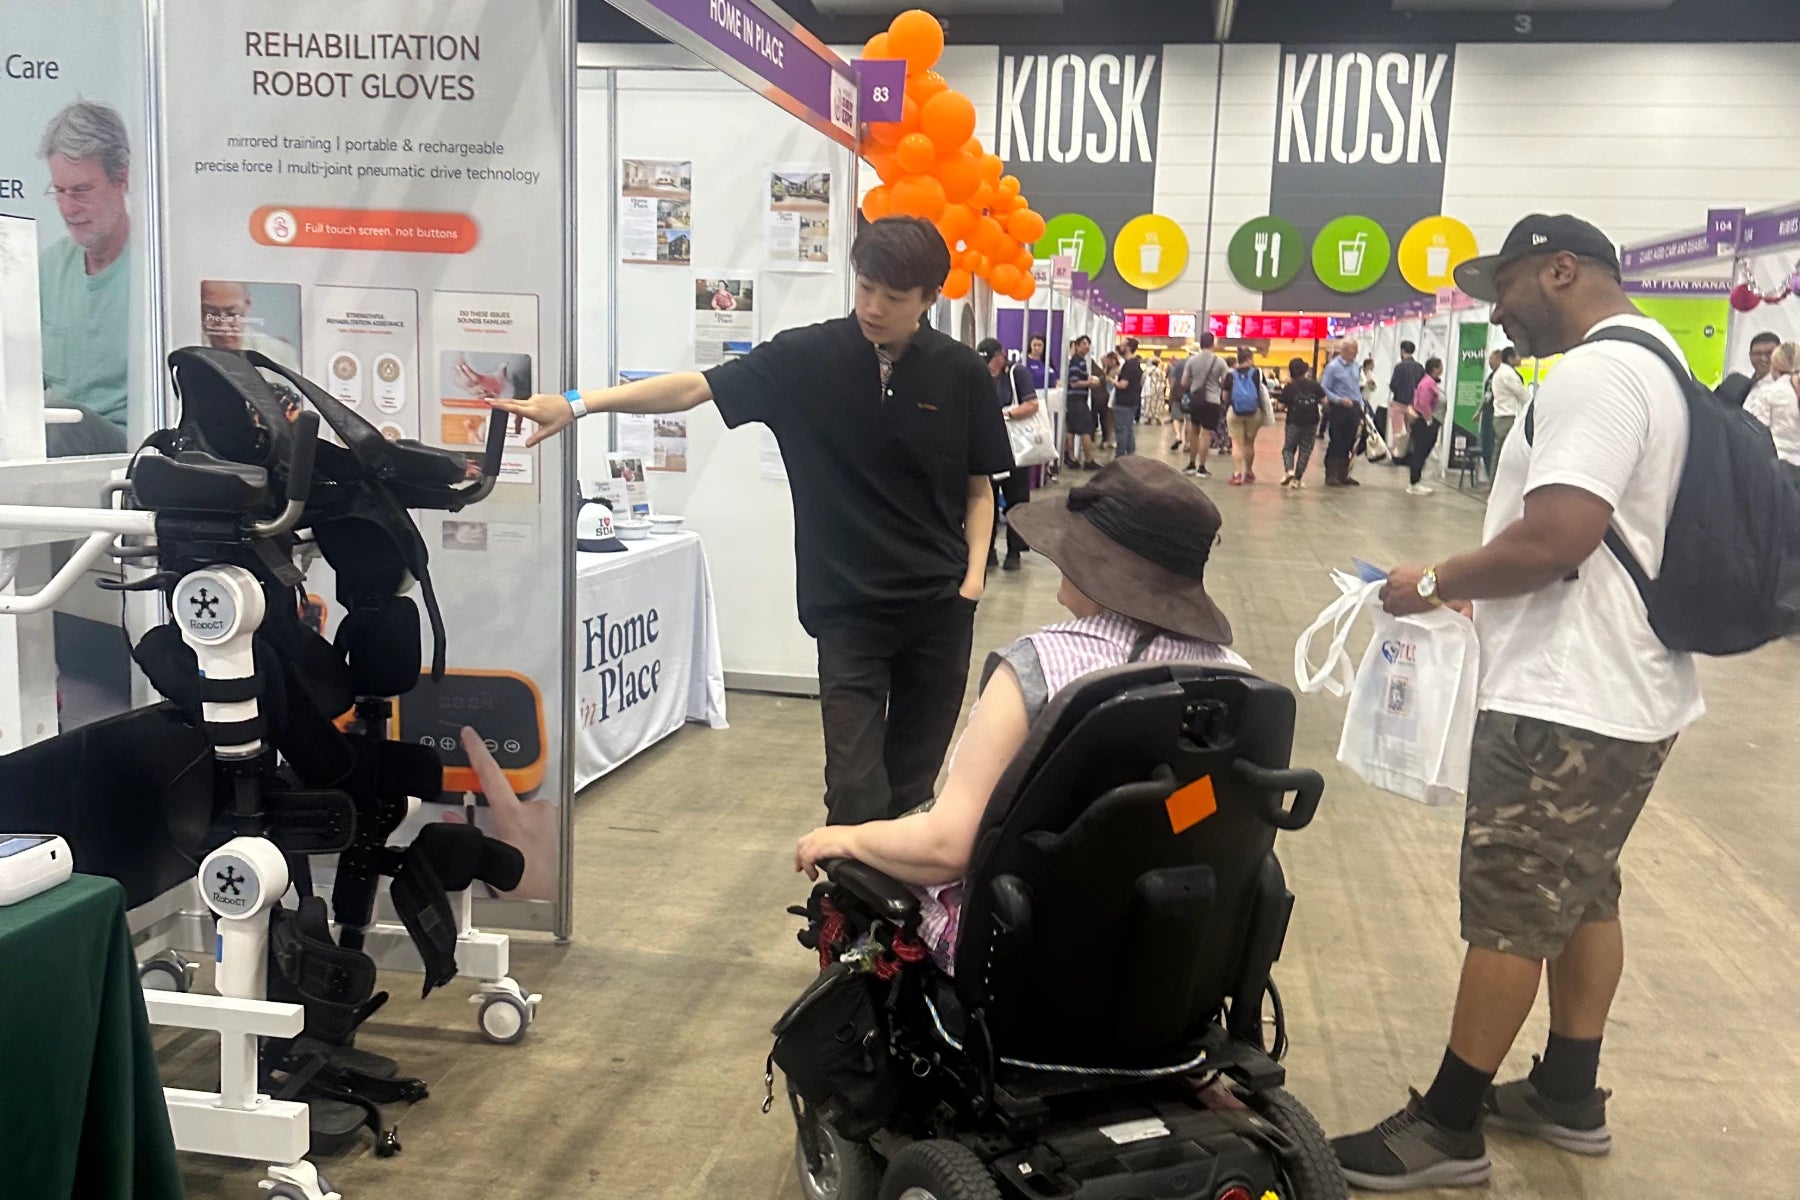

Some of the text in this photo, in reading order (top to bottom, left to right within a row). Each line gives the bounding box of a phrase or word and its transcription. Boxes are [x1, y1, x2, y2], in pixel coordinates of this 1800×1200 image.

[710, 0, 783, 69] HOME IN PLACE
[1513, 14, 1532, 33] 3
[245, 31, 480, 61] REHABILITATION
[5, 53, 59, 79] Care
[252, 70, 475, 101] ROBOT GLOVES
[873, 86, 889, 102] 83
[1000, 53, 1156, 163] KIOSK
[1278, 52, 1448, 164] KIOSK
[227, 135, 504, 157] mirrored training portable & rechargeable
[194, 159, 239, 173] precise
[242, 159, 273, 172] force
[357, 165, 426, 180] pneumatic
[430, 166, 462, 179] drive
[467, 168, 540, 184] technology
[305, 223, 323, 233] Full
[326, 225, 355, 235] touch
[396, 229, 412, 237] not
[417, 228, 458, 239] buttons
[1715, 221, 1732, 232] 104
[1641, 279, 1657, 289] MY
[190, 620, 224, 630] RoboCT
[582, 608, 659, 672] Home
[598, 658, 661, 723] Place
[213, 892, 248, 907] RoboCT
